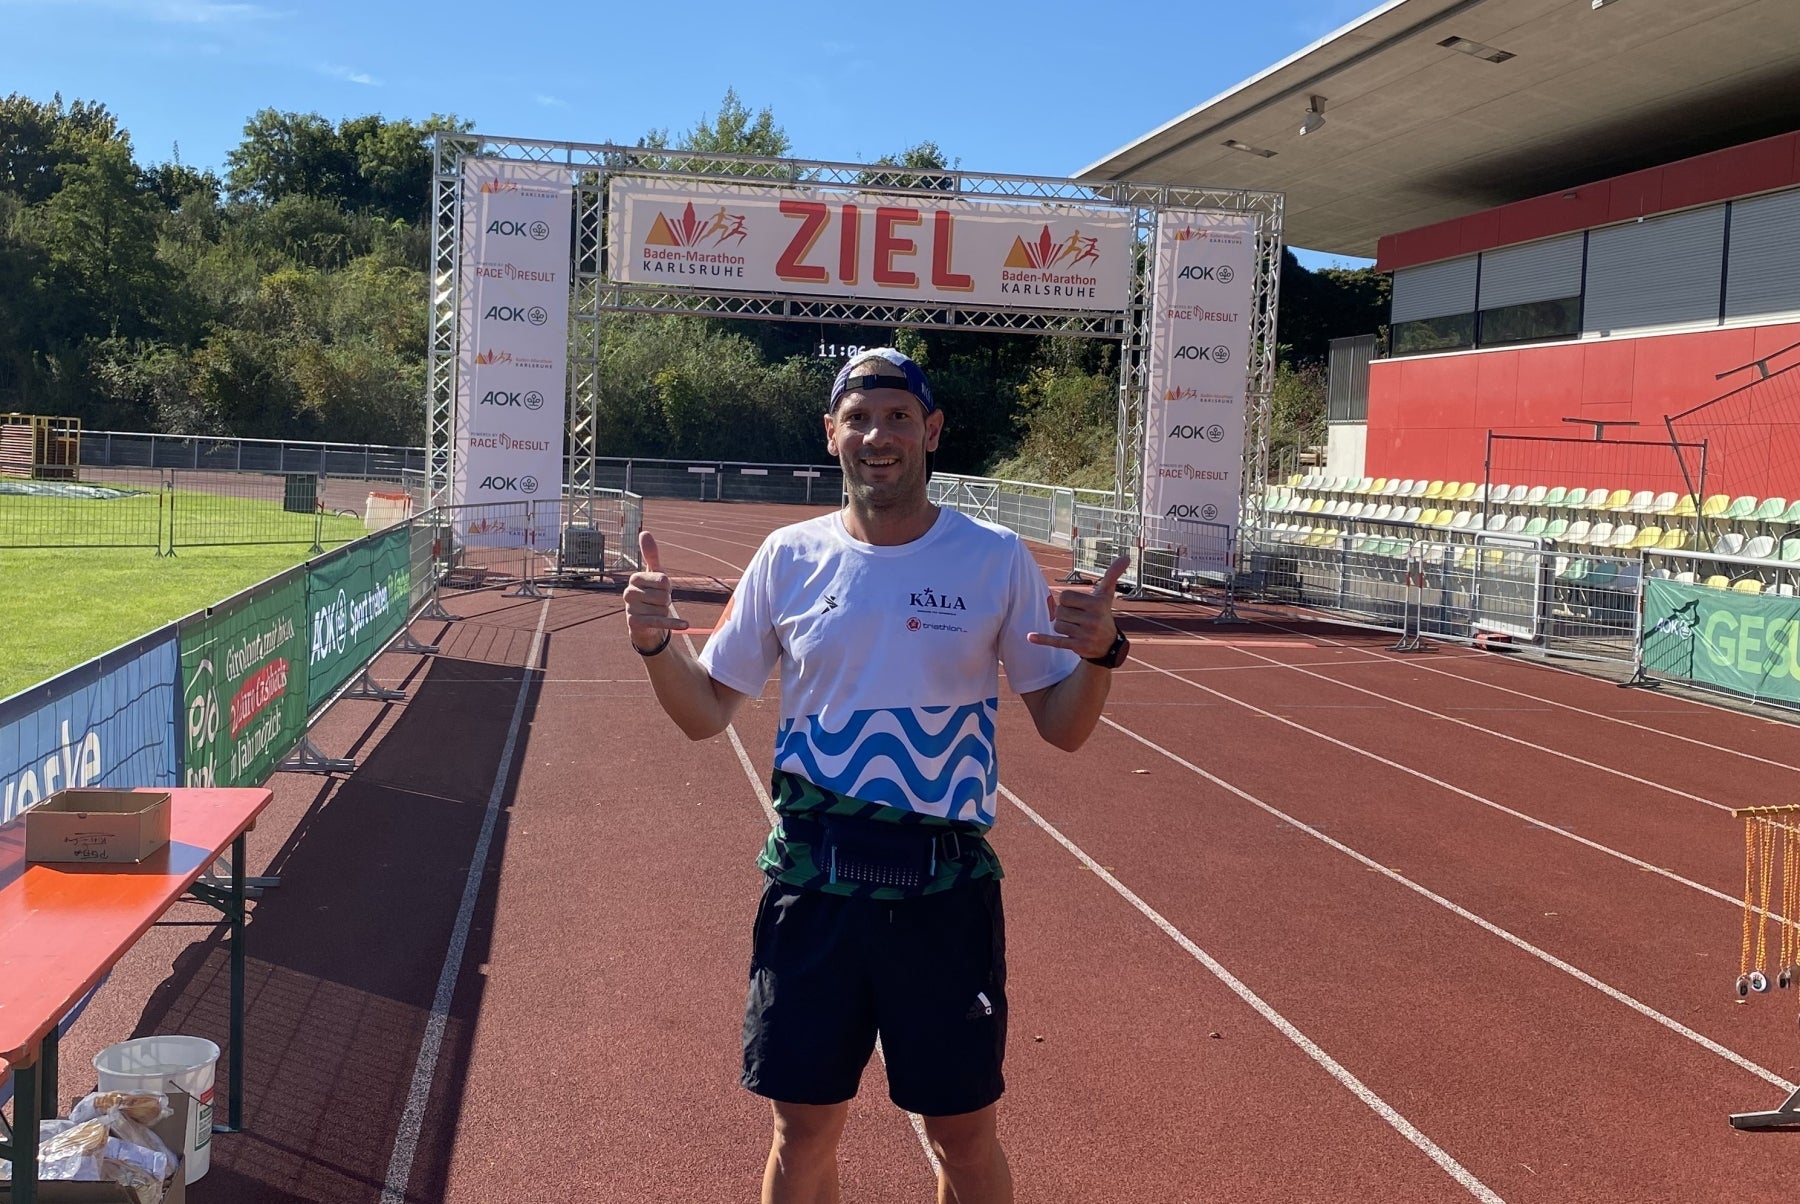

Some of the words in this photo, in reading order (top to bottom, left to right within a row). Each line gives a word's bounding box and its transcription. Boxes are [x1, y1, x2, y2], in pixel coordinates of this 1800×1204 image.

[486, 220, 527, 237] AOK
[776, 200, 974, 293] ZIEL
[643, 248, 745, 265] Baden-Marathon
[476, 268, 503, 279] RACE
[517, 270, 556, 282] RESULT
[643, 261, 744, 278] KARLSRUHE
[1178, 265, 1215, 281] AOK
[1002, 270, 1097, 286] Baden-Marathon
[1001, 283, 1096, 298] KARLSRUHE
[484, 306, 526, 322] AOK
[1167, 309, 1192, 320] RACE
[1204, 312, 1239, 323] RESULT
[1174, 345, 1211, 361] AOK
[480, 391, 522, 407] AOK
[1168, 424, 1205, 440] AOK
[470, 437, 498, 449] RACE
[511, 440, 550, 451] RESULT
[1158, 468, 1183, 479] RACE
[1195, 470, 1229, 481] RESULT
[479, 476, 518, 491] AOK
[1165, 504, 1200, 518] AOK
[909, 588, 967, 610] KALA
[310, 601, 336, 666] AOK
[1655, 617, 1679, 635] AOK
